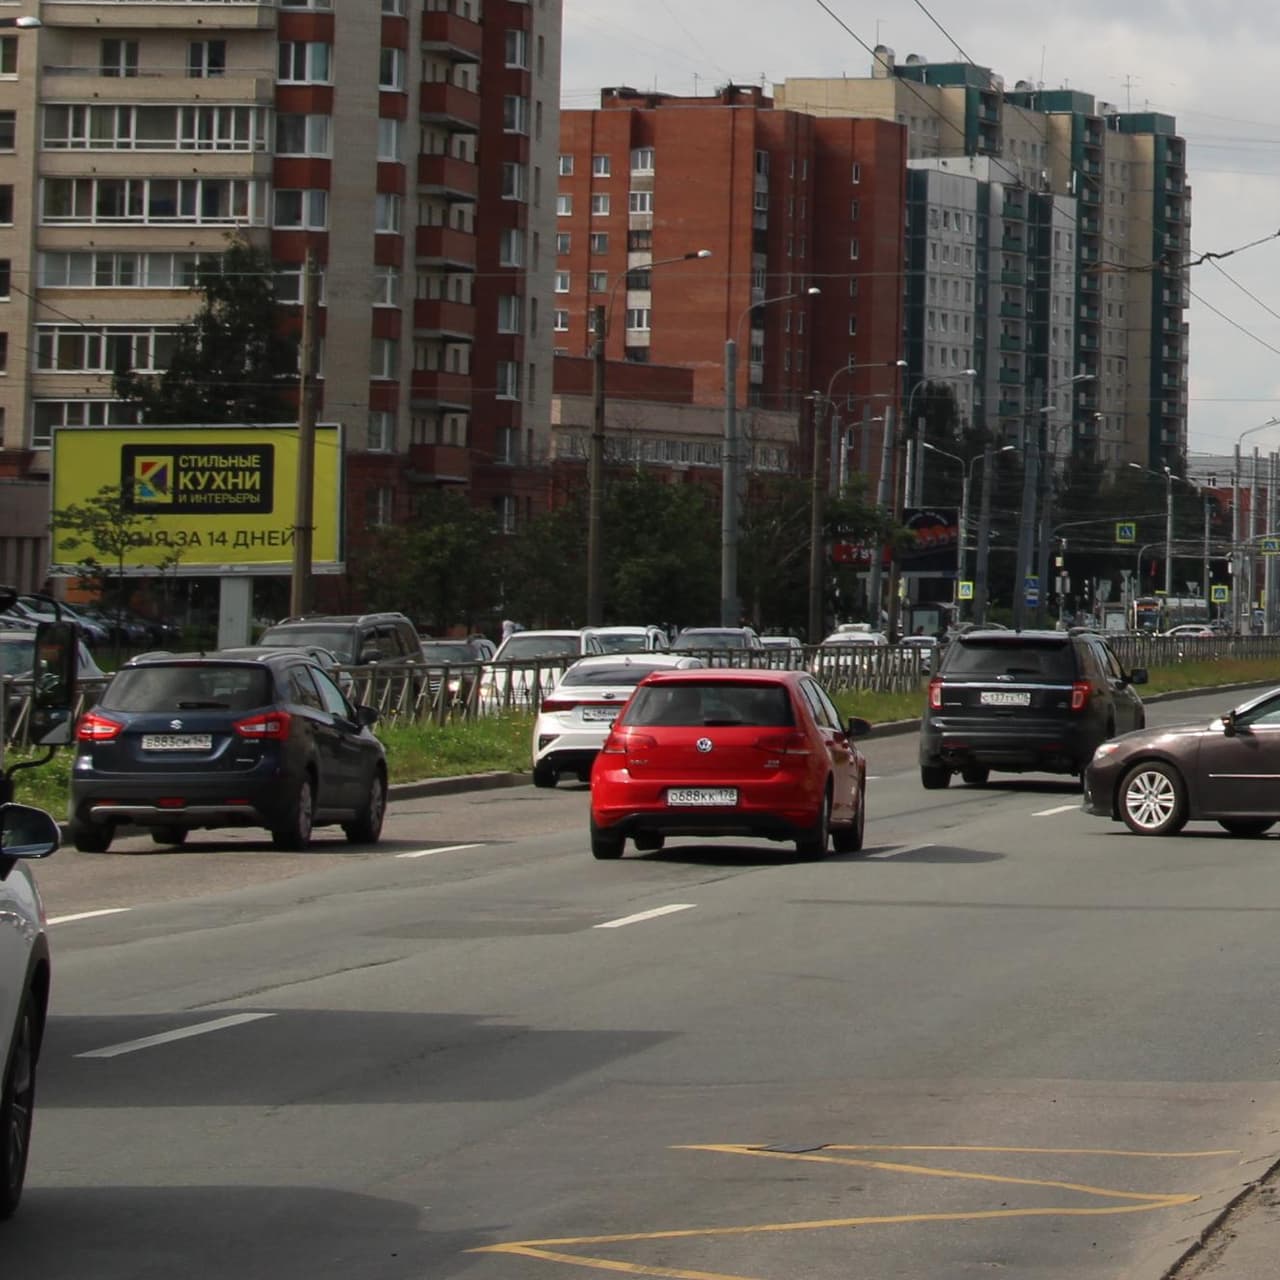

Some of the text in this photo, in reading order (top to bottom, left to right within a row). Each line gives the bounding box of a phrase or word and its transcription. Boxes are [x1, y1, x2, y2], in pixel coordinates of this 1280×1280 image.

[178, 454, 261, 468] СТИЛЬНЫЕ
[178, 471, 261, 490] КУХНИ
[178, 492, 261, 504] И ИНТЕРЬЕРЫ
[175, 531, 202, 546] ЗА
[208, 531, 228, 546] 14
